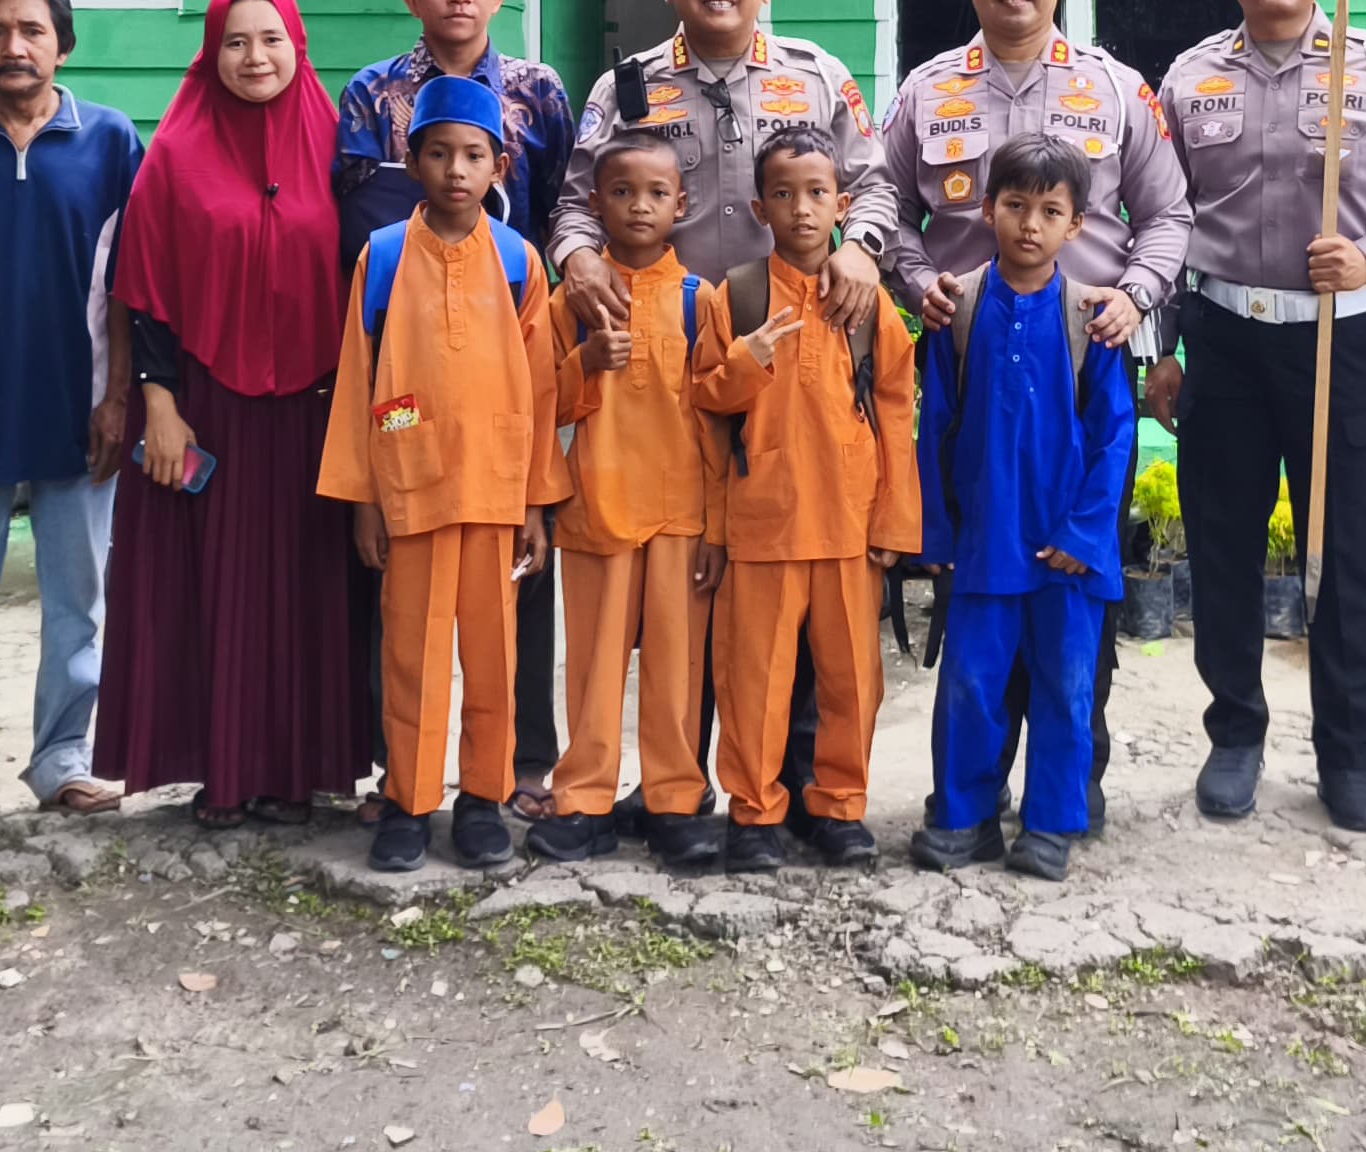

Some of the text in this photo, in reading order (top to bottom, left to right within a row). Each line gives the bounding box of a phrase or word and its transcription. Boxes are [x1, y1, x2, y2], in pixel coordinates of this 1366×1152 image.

[1190, 96, 1236, 114] RONI
[1306, 92, 1363, 109] PORI
[929, 117, 982, 136] BUDI.S
[1050, 113, 1107, 132] POLRI
